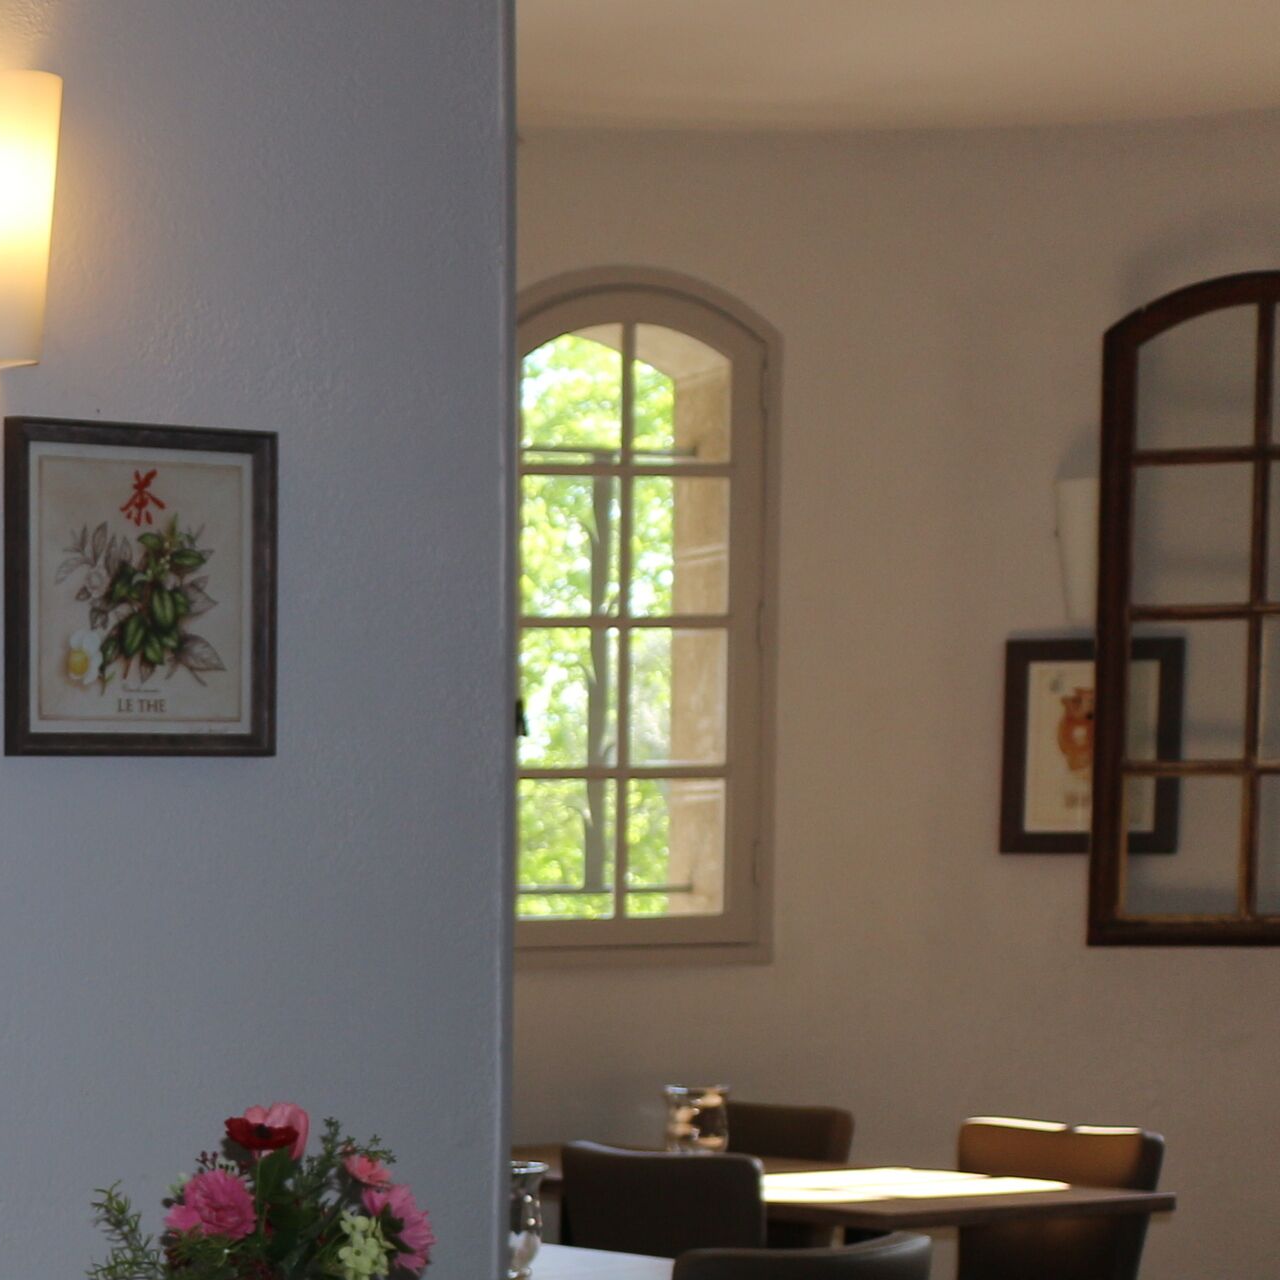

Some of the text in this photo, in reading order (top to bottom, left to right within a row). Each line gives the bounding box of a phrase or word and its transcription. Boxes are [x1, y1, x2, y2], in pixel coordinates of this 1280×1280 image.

[119, 468, 166, 527] 茶
[117, 698, 167, 713] LE THE
